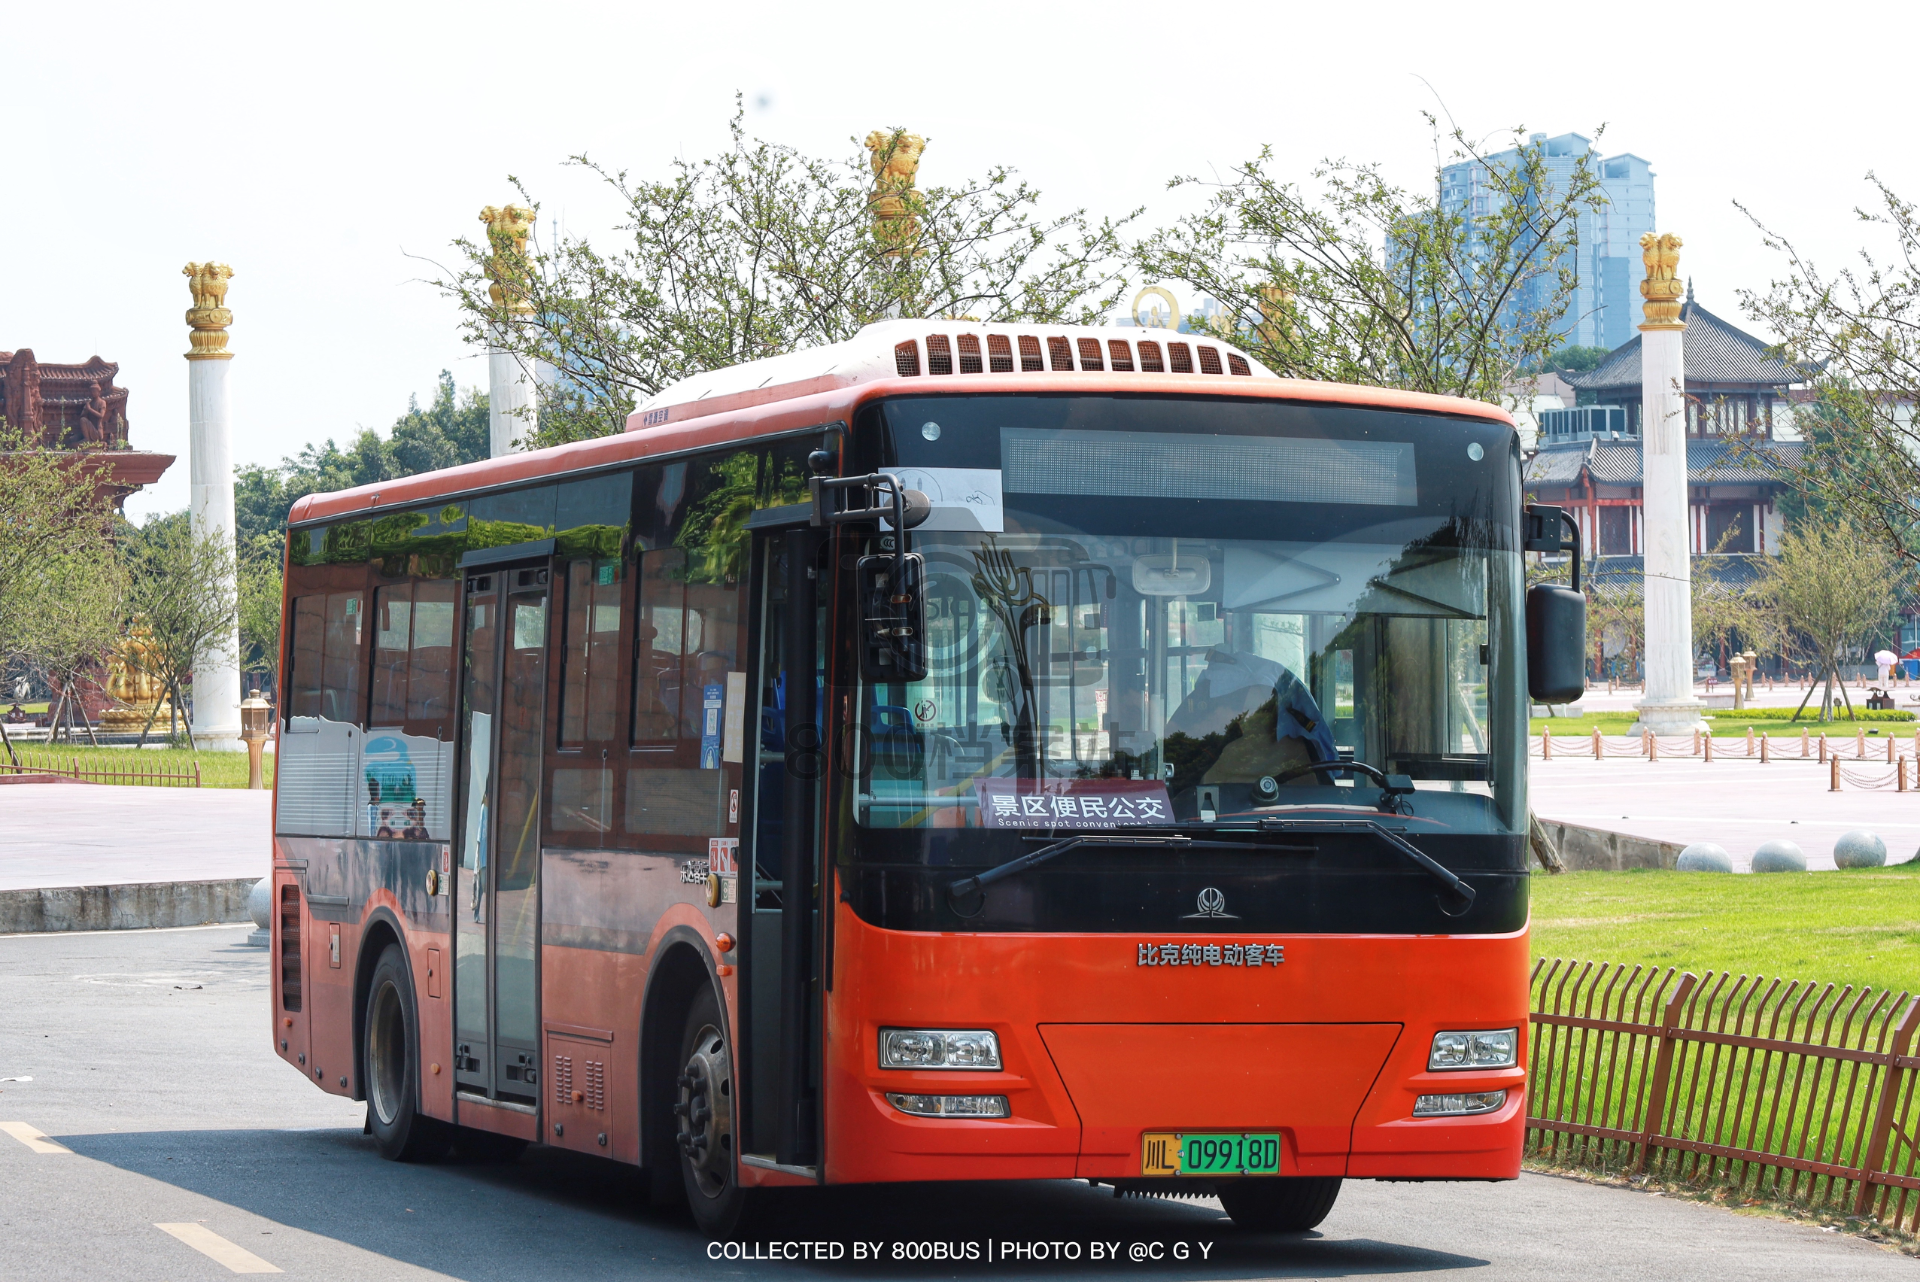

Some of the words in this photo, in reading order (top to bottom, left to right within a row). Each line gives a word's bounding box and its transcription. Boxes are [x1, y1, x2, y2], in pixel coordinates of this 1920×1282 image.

[992, 795, 1166, 818] 景区便民公交
[998, 819, 1040, 828] Scenic
[1044, 820, 1071, 830] spot
[1137, 943, 1285, 966] 比克纯电动客车
